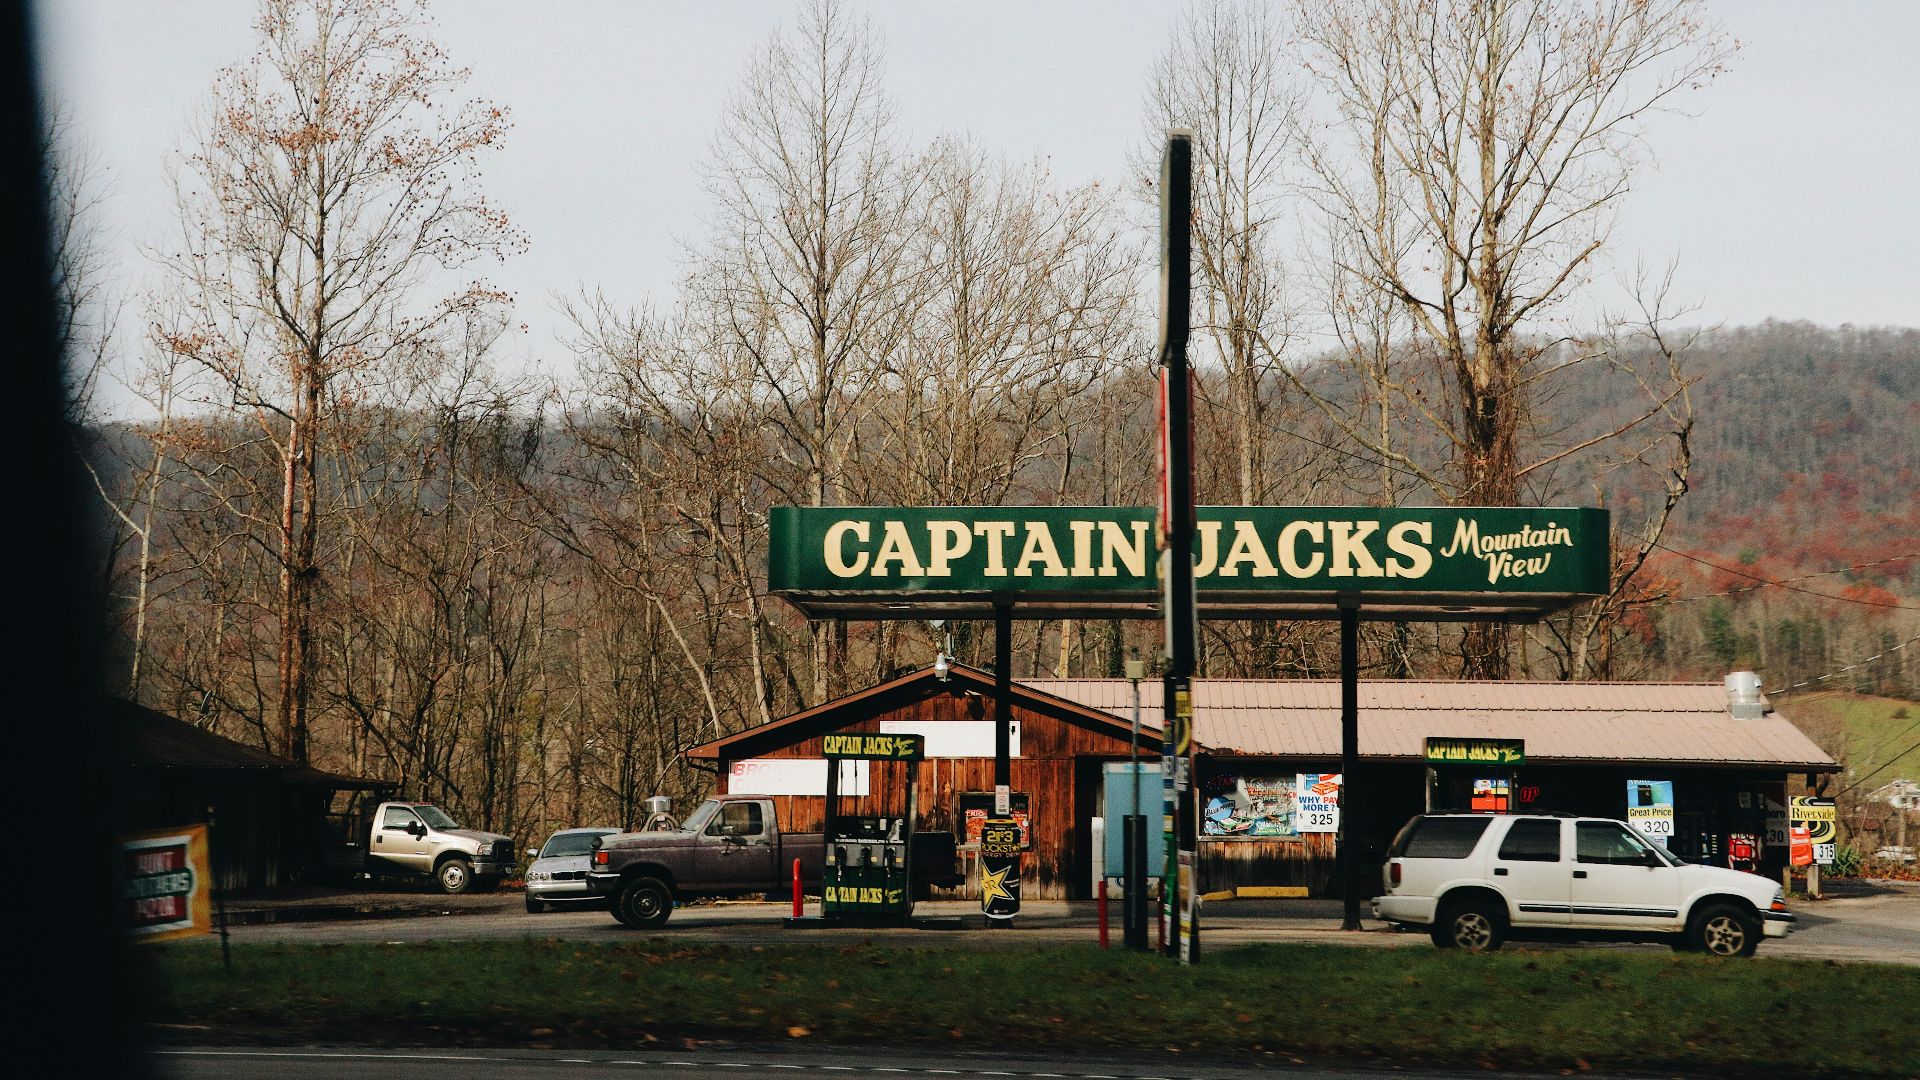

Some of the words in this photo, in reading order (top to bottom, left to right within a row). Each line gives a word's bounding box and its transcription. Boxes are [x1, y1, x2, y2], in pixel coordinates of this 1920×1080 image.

[1440, 518, 1574, 559] Mountain
[823, 520, 1149, 578] CAPTAIN
[1193, 520, 1432, 579] JACKS
[1482, 551, 1552, 585] View
[824, 736, 862, 754] CAPTAIN
[864, 737, 893, 755] JACKS
[1427, 742, 1468, 759] CAPTAIN
[1468, 743, 1499, 760] JACKS
[1299, 796, 1321, 804] WHY
[1310, 813, 1333, 825] 325
[1629, 808, 1651, 817] Great
[1652, 808, 1672, 816] Price
[1792, 807, 1834, 819] Riverside
[1643, 820, 1670, 833] 320
[1819, 845, 1834, 858] 315
[826, 886, 857, 902] CATAIN
